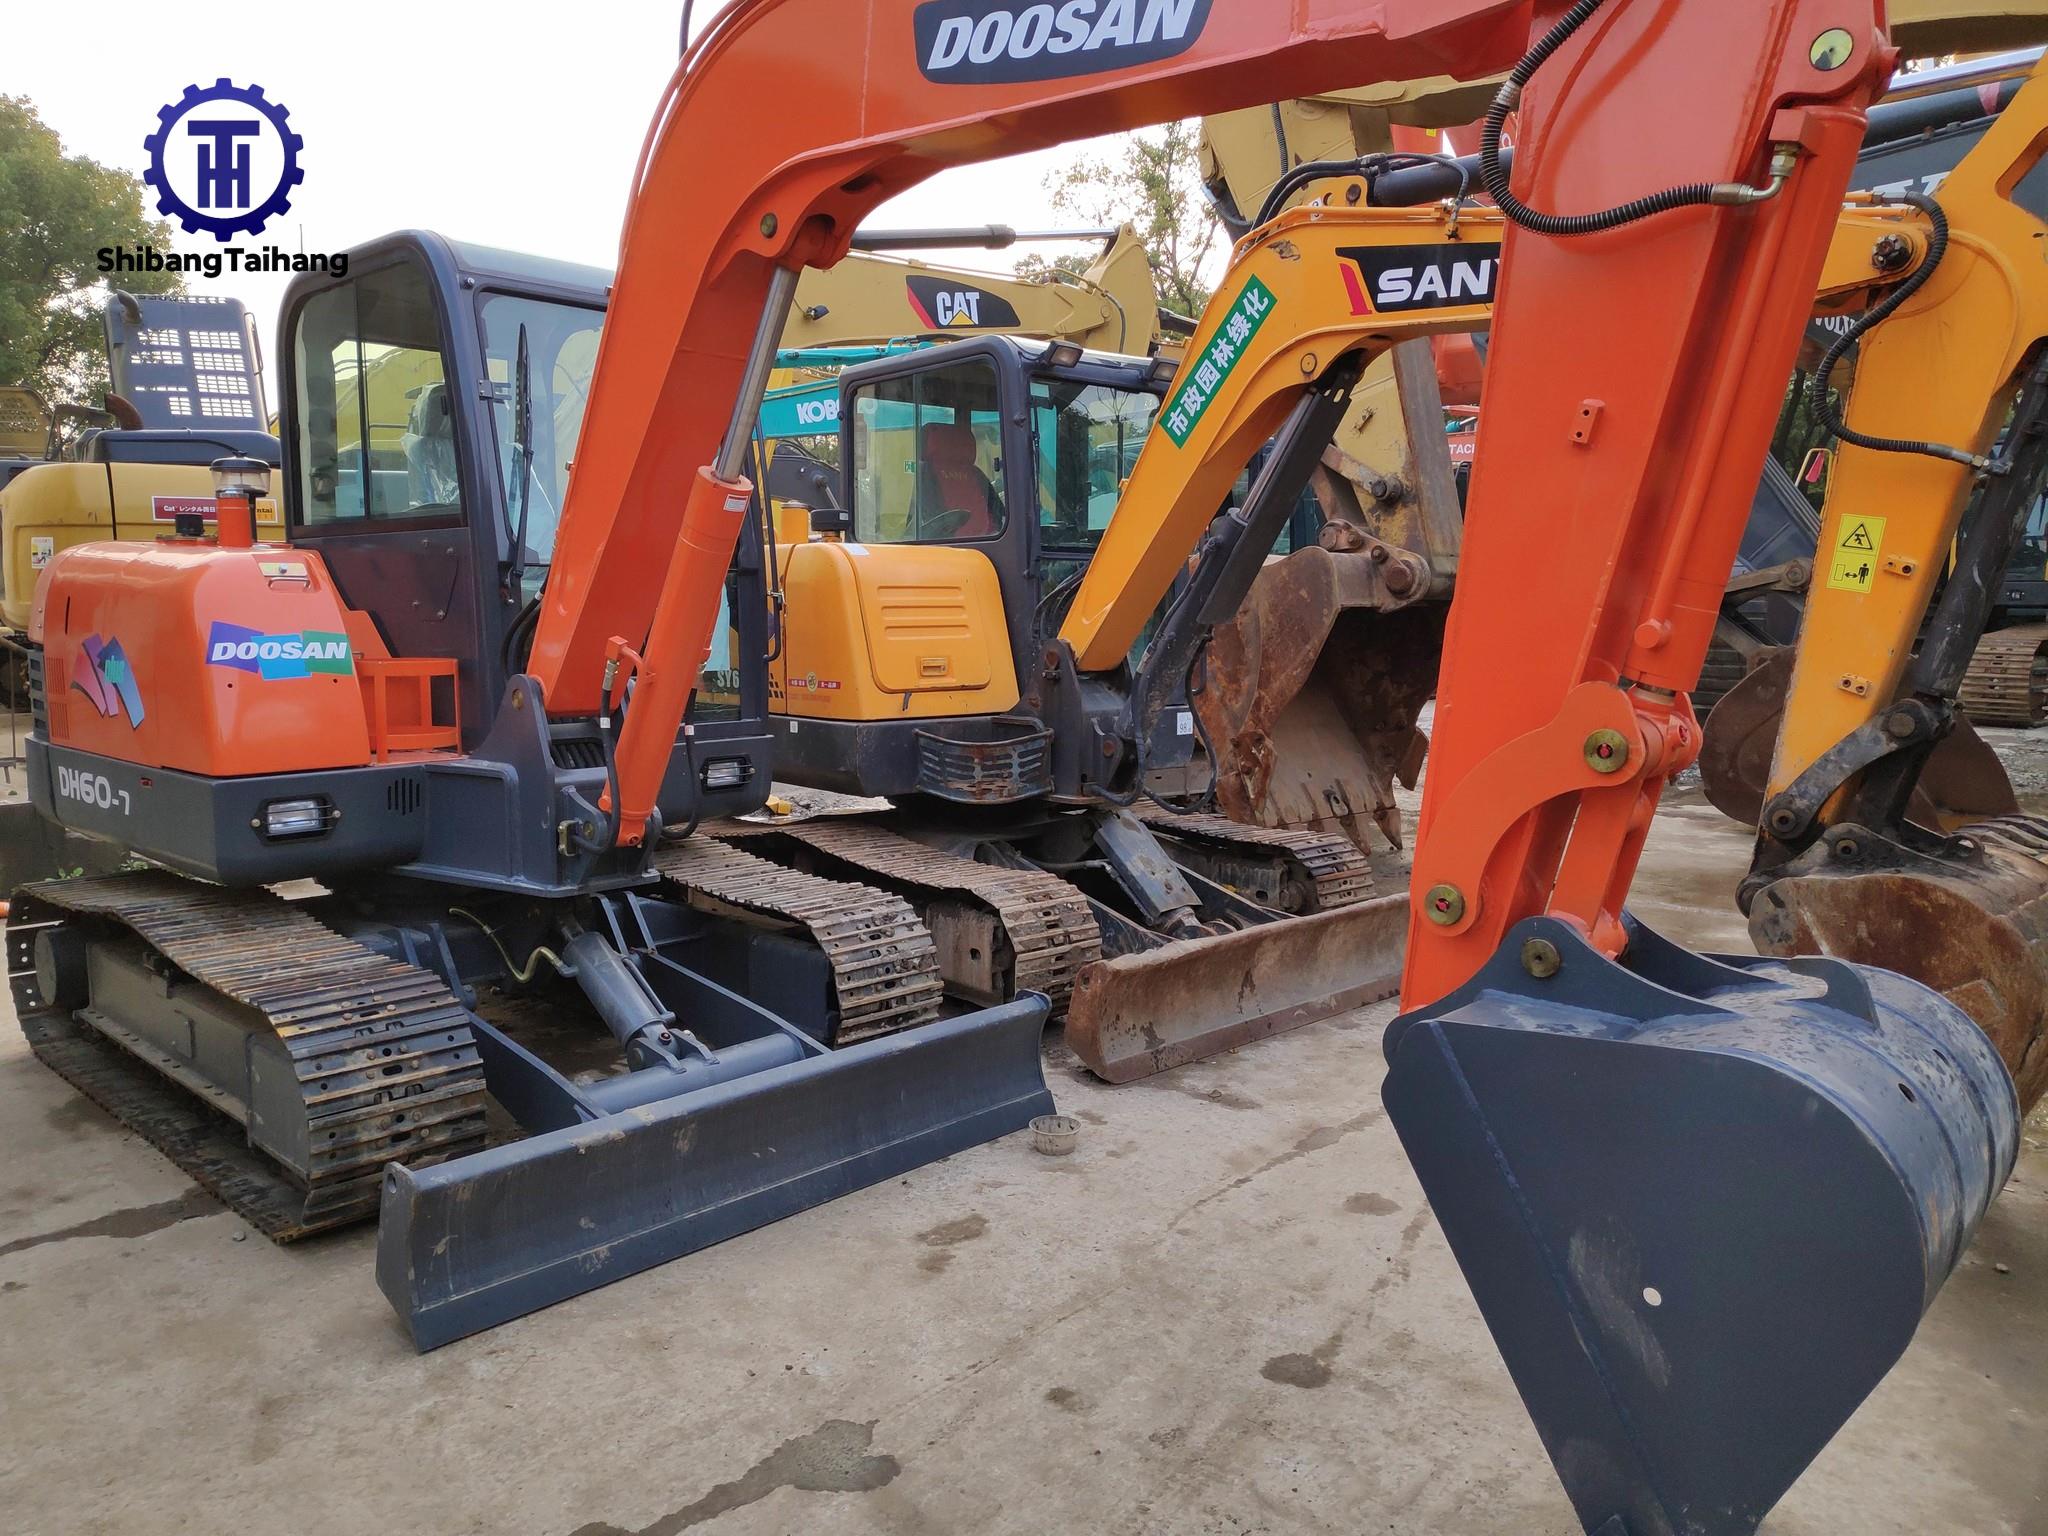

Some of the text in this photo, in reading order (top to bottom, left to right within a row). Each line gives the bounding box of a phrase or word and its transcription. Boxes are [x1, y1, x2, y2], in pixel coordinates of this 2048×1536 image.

[926, 0, 1195, 70] DOOSAN
[1377, 258, 1501, 304] SAN
[936, 291, 980, 326] CAT
[1167, 287, 1269, 436] 市政园林绿化
[211, 641, 348, 662] DOOSAN
[58, 765, 130, 816] DH60-7
